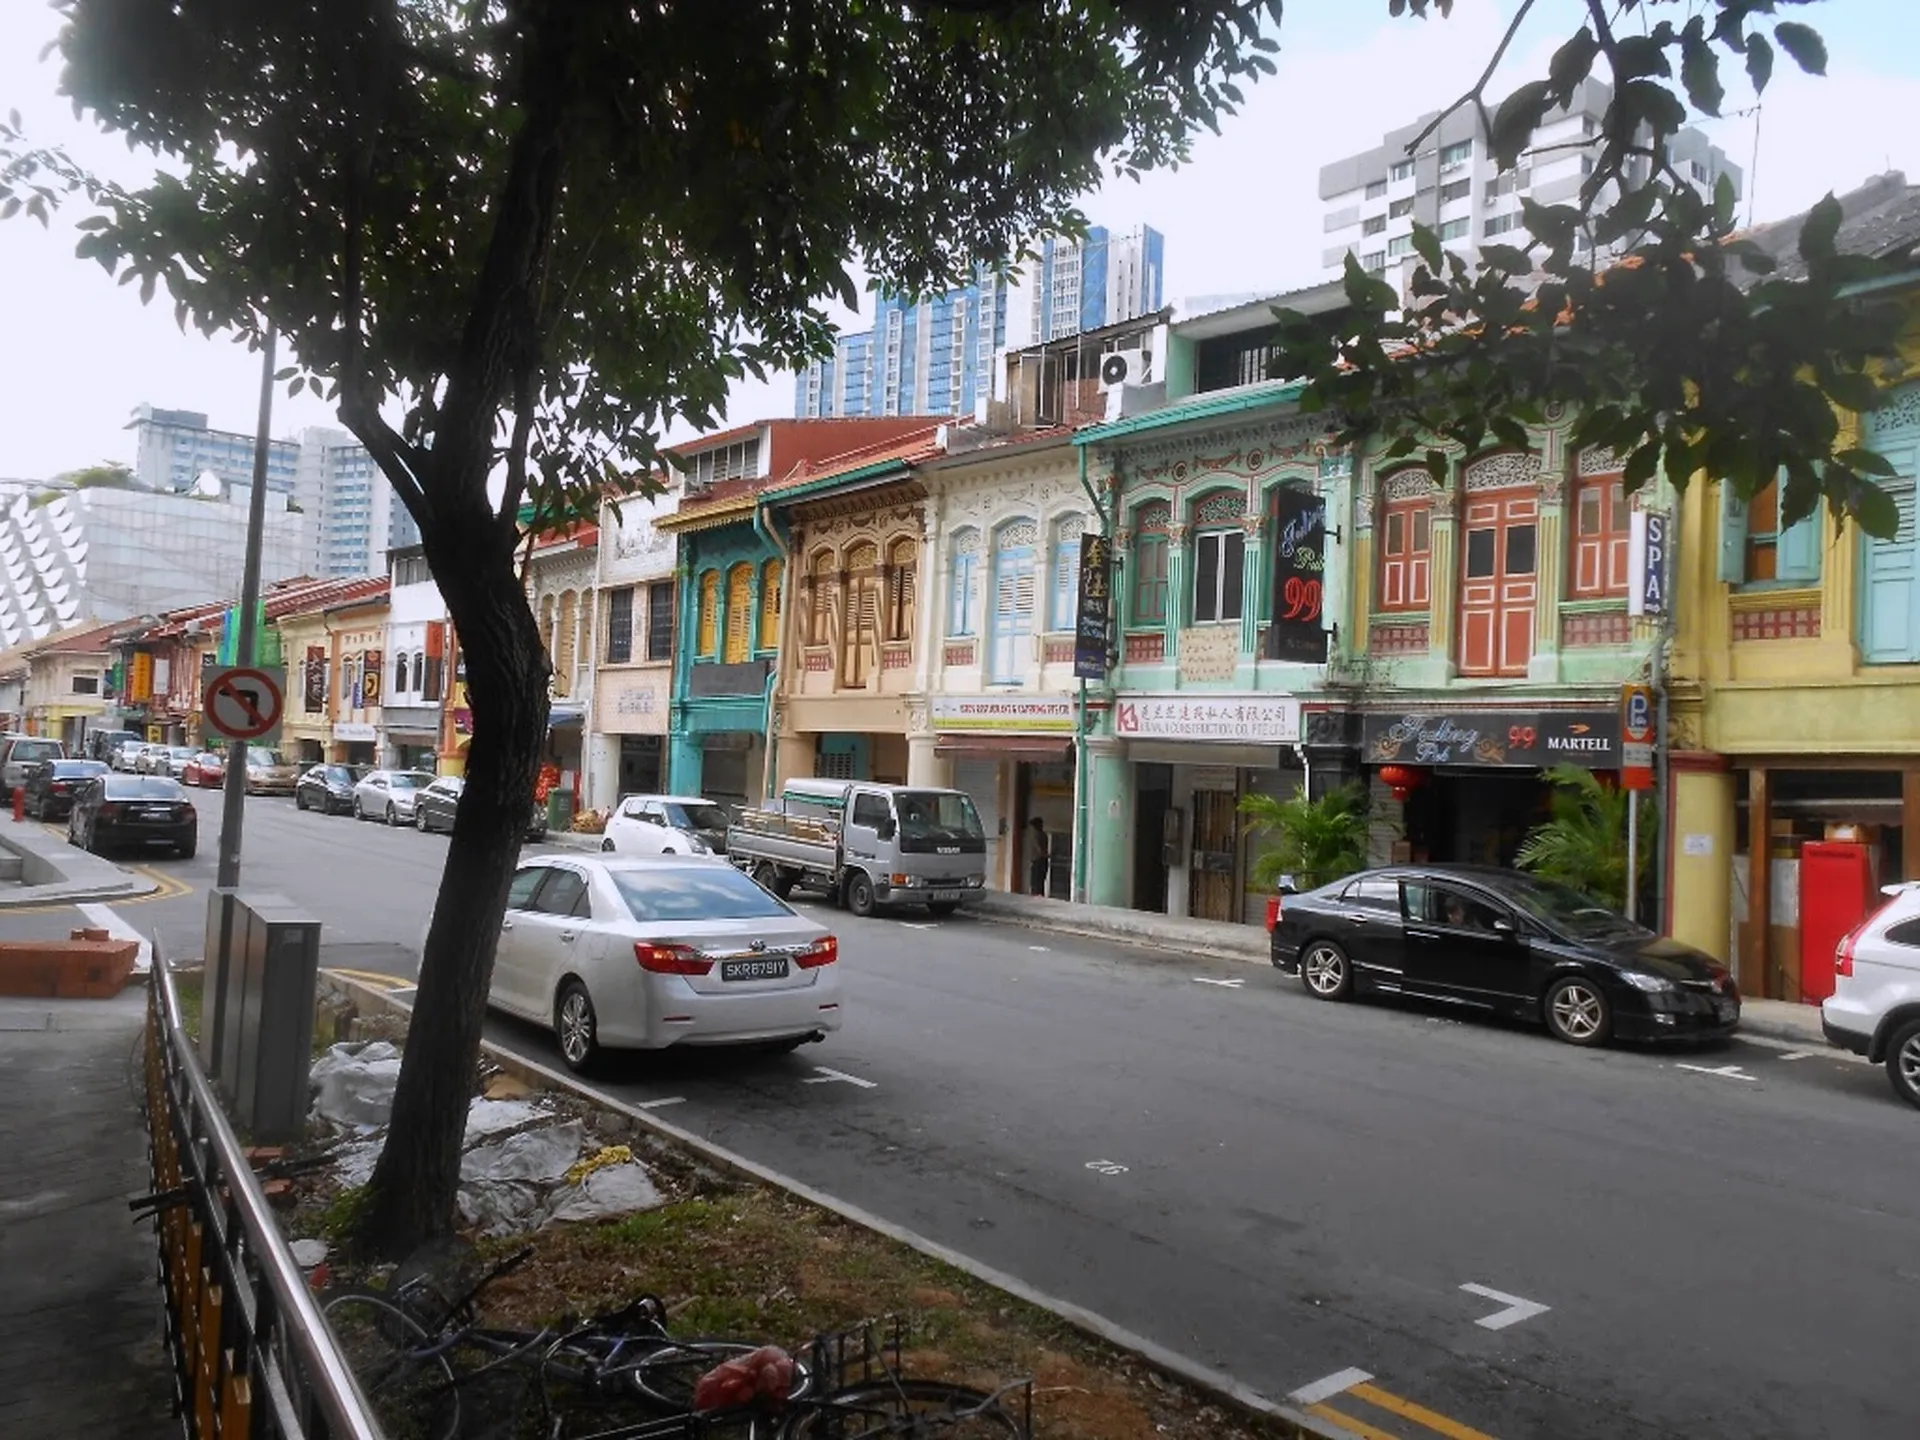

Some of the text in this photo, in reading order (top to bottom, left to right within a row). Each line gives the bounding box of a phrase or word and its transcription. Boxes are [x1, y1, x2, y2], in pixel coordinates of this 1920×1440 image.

[1646, 517, 1662, 599] SPA
[1283, 576, 1322, 622] 99
[1630, 694, 1648, 728] P
[1389, 713, 1479, 753] Feeling
[1508, 725, 1538, 750] 99
[1547, 736, 1612, 751] MARTELL
